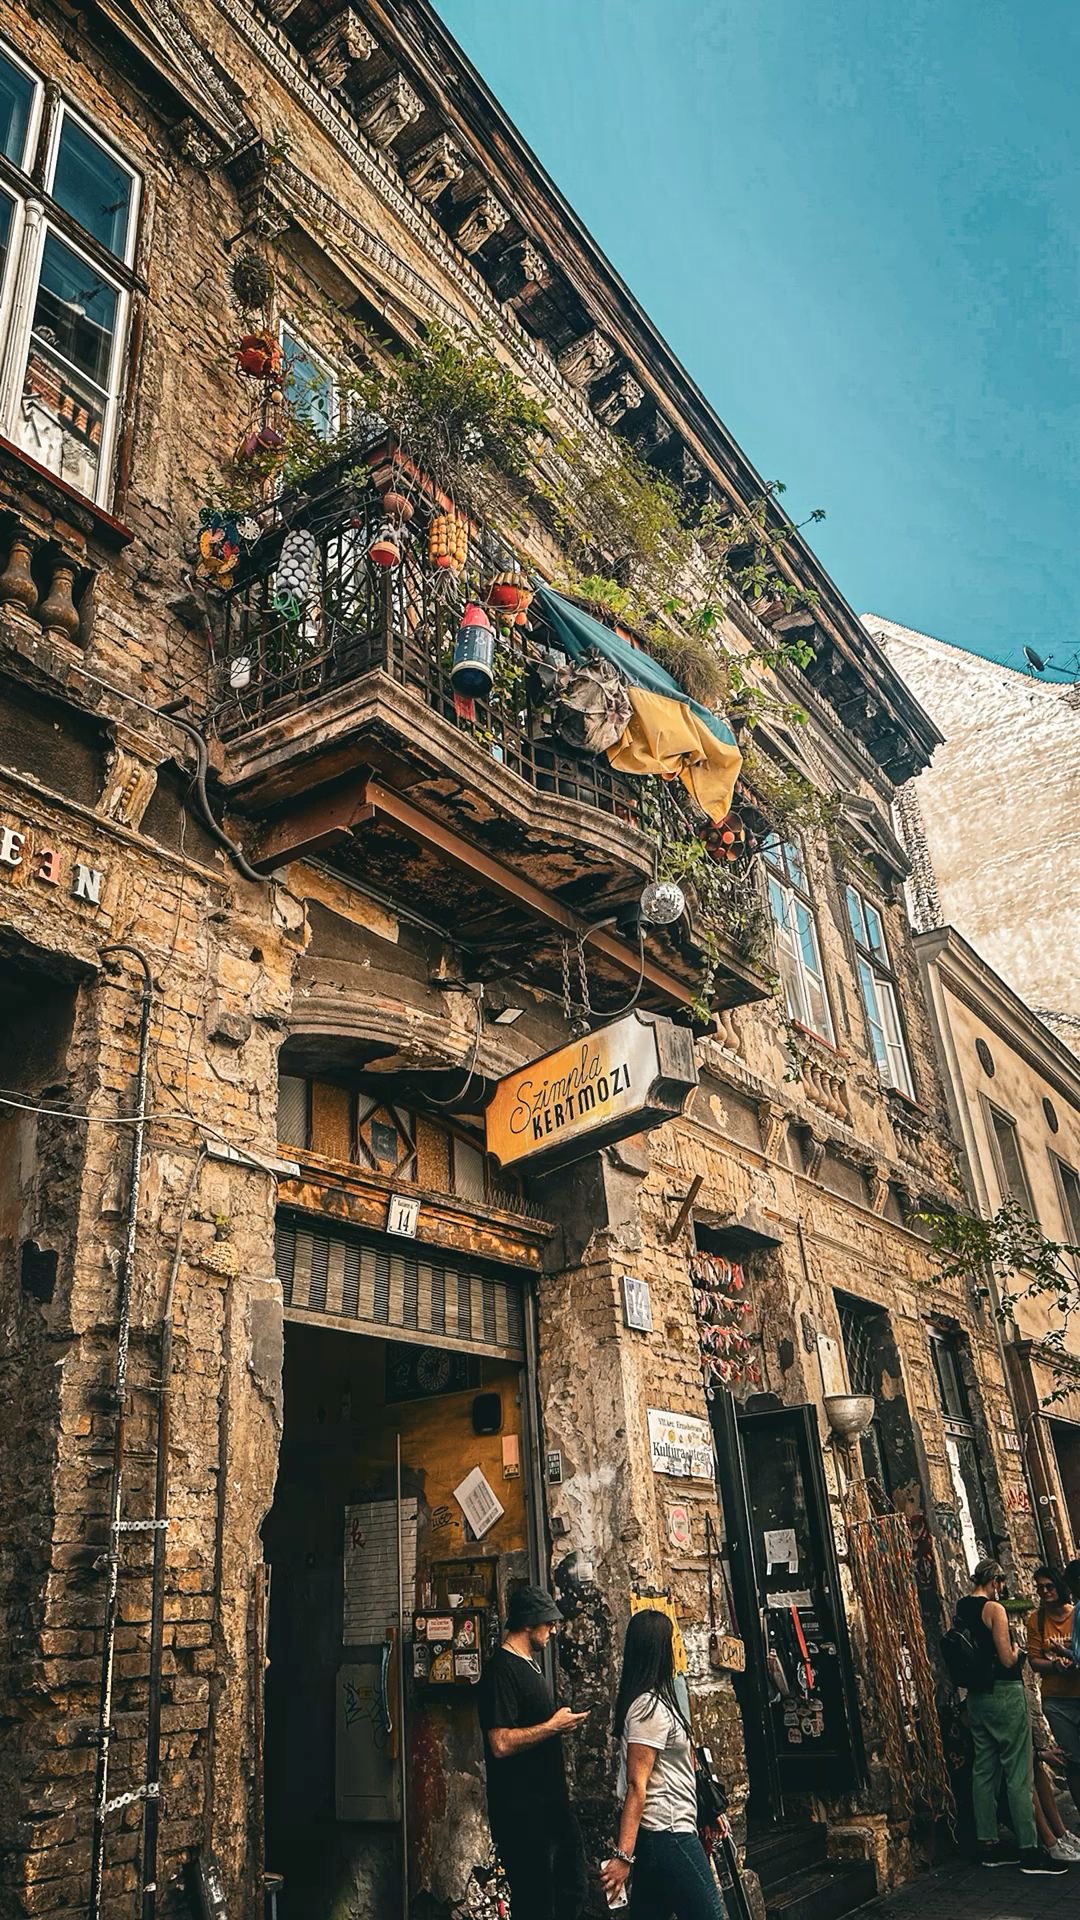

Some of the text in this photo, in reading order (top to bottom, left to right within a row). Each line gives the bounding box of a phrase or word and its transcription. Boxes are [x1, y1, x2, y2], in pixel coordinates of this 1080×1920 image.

[510, 1044, 602, 1134] Szimpla
[532, 1063, 631, 1140] KERTMOZI
[397, 1209, 411, 1231] 14
